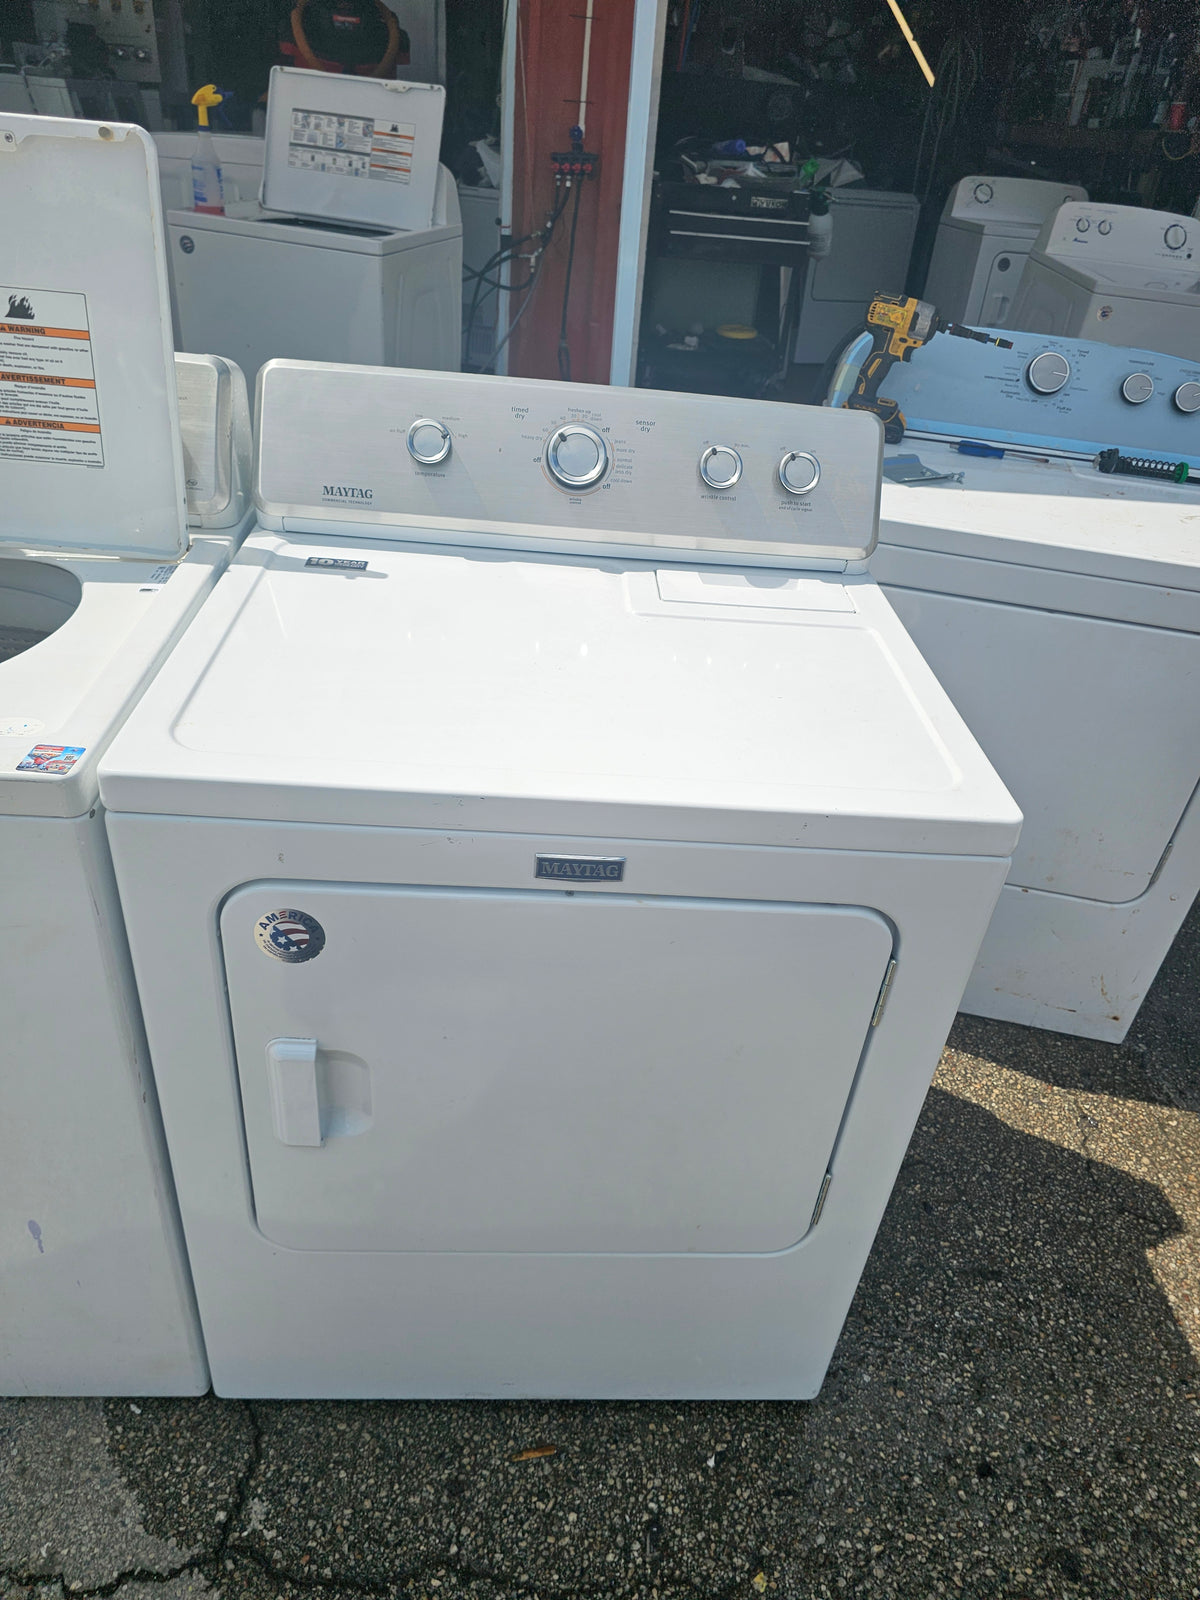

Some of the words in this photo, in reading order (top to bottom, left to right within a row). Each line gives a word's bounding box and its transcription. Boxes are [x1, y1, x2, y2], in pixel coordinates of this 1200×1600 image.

[7, 325, 46, 335] WARNING
[1, 373, 66, 385] AVERTISSEMENT
[511, 406, 529, 414] timed
[514, 412, 525, 421] dry
[13, 419, 65, 429] ADVERTENCIA
[640, 425, 651, 433] dry
[322, 485, 373, 499] MAYTAG
[309, 557, 335, 566] 10
[335, 559, 367, 567] YEAR
[540, 861, 619, 877] MAYTAG
[258, 910, 320, 933] AMERICA
